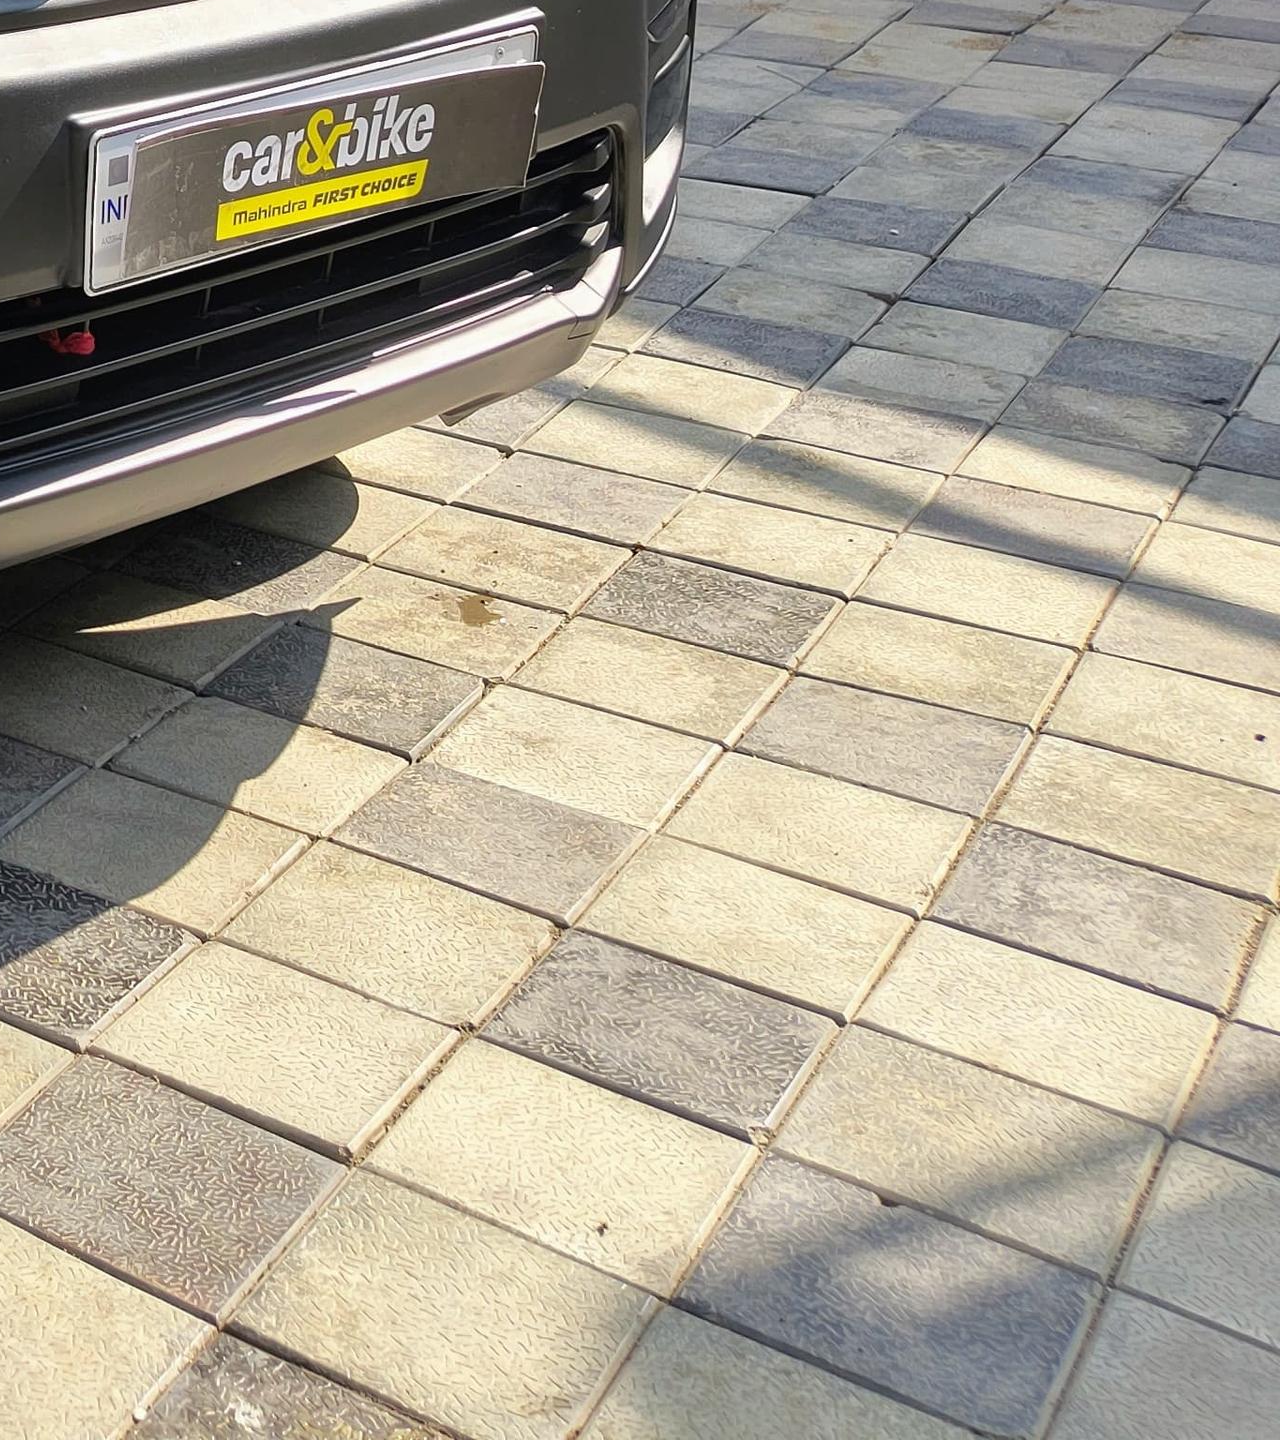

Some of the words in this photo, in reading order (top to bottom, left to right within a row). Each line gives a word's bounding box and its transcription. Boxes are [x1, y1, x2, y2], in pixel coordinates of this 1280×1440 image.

[222, 95, 436, 192] car&bike
[233, 198, 308, 226] Mahindra
[312, 185, 360, 209] FIRST
[360, 172, 418, 198] CHOICE
